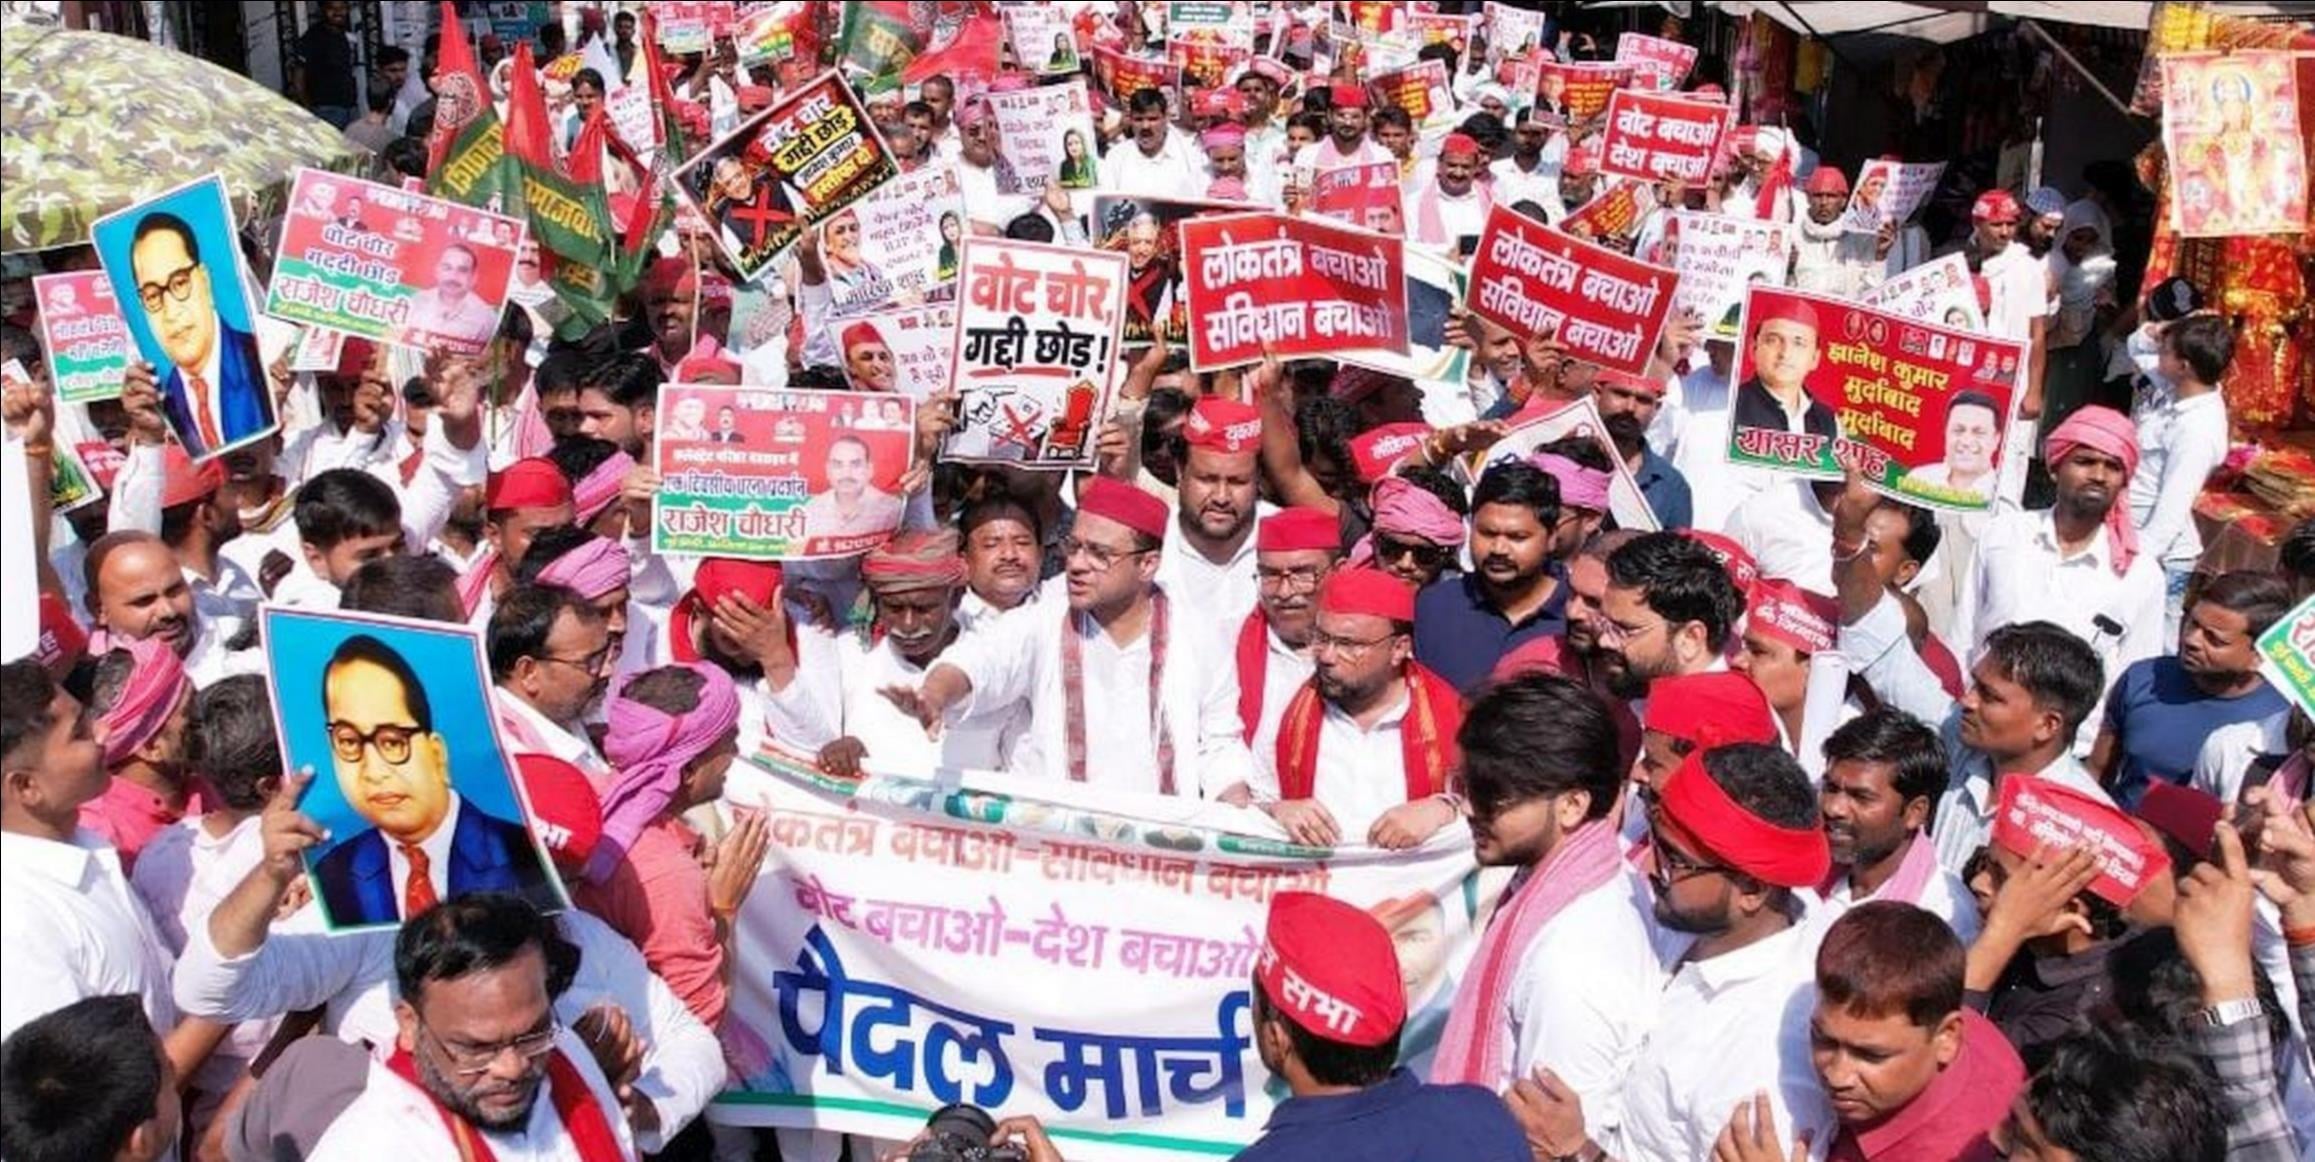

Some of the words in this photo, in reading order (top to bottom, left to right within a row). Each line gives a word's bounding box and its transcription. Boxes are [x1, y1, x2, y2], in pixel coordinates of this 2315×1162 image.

[1617, 103, 1656, 138] वोट
[1656, 113, 1719, 147] बचाओ
[1609, 136, 1648, 171] देश
[1649, 148, 1711, 178] बचाओ
[1201, 225, 1302, 290] लोकतंत्र
[1309, 244, 1388, 291] बचाओ
[1490, 226, 1582, 293] लोकतंत्र
[1582, 266, 1661, 317] बचाओ
[971, 252, 1040, 314] वोट
[1046, 258, 1114, 327] चोर,
[1310, 299, 1393, 339] बचाओ
[1565, 317, 1644, 361] बचाओ
[964, 316, 1028, 370] गद्दी
[1828, 341, 1887, 374] ज्ञानेश
[1892, 359, 1949, 392] कुमार
[1844, 374, 1922, 418] मुर्दाबाद
[1737, 427, 1828, 465] यासर
[1840, 407, 1917, 451] मुर्दाबाद
[663, 503, 728, 535] राजेश
[737, 504, 808, 539] चौधरी
[791, 873, 858, 930] वोट
[1119, 924, 1259, 979] बचाओ
[774, 922, 1015, 1107] पैदल
[1033, 989, 1253, 1120] मार्च
[1282, 965, 1363, 1035] सभा
